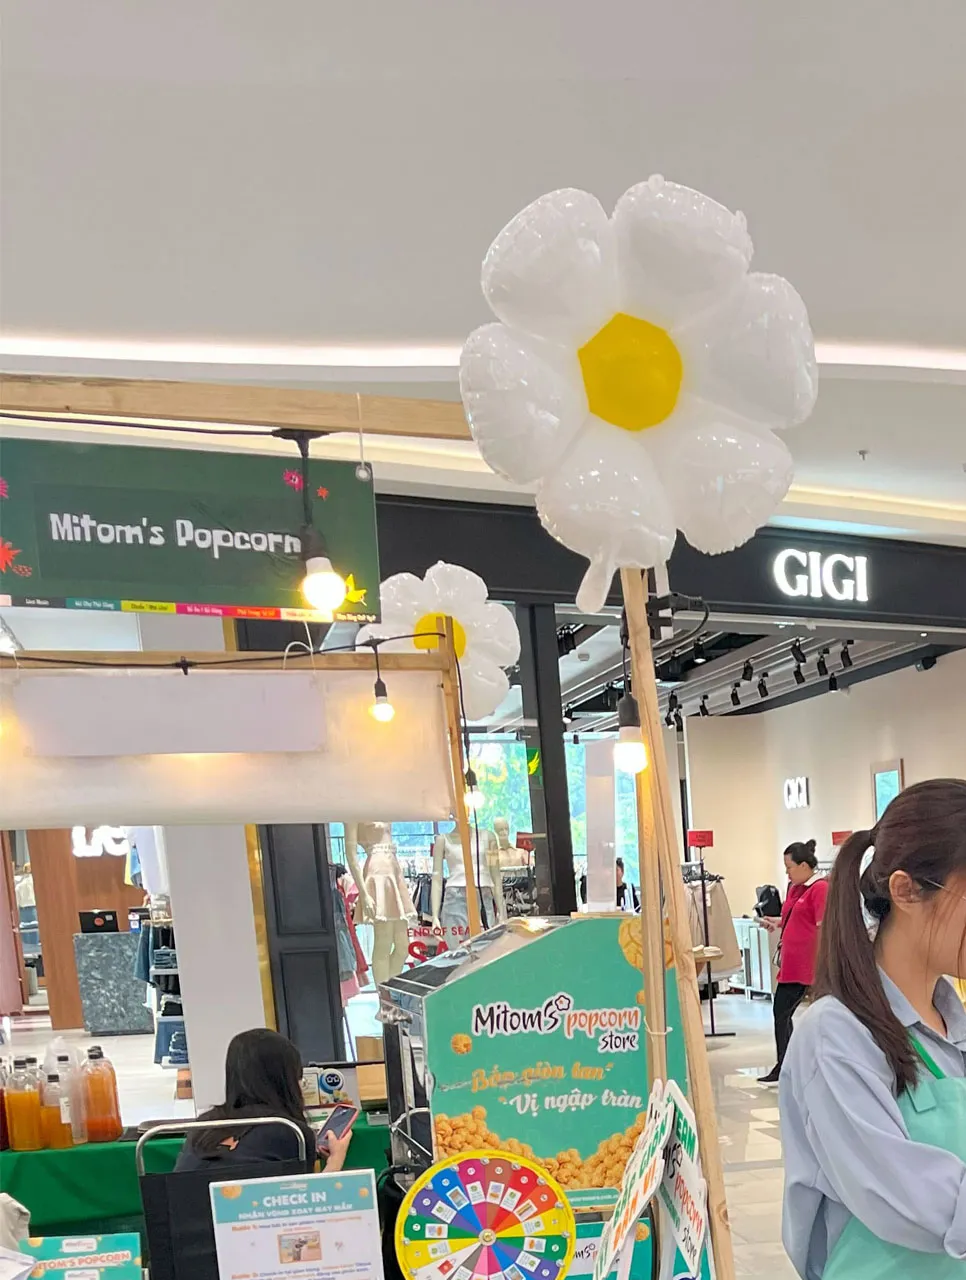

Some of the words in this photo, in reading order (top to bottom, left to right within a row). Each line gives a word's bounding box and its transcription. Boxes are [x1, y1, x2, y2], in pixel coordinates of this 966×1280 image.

[50, 513, 165, 546] Mitom's
[175, 519, 301, 558] Popcorn
[773, 548, 869, 602] GIGI
[433, 926, 447, 936] OF
[474, 1000, 559, 1034] Mitom's
[566, 1008, 640, 1035] popcorn
[600, 1033, 637, 1050] store
[601, 1089, 643, 1109] tràn
[262, 1194, 309, 1208] CHECK
[311, 1191, 327, 1202] IN
[78, 1252, 130, 1265] POPCORN
